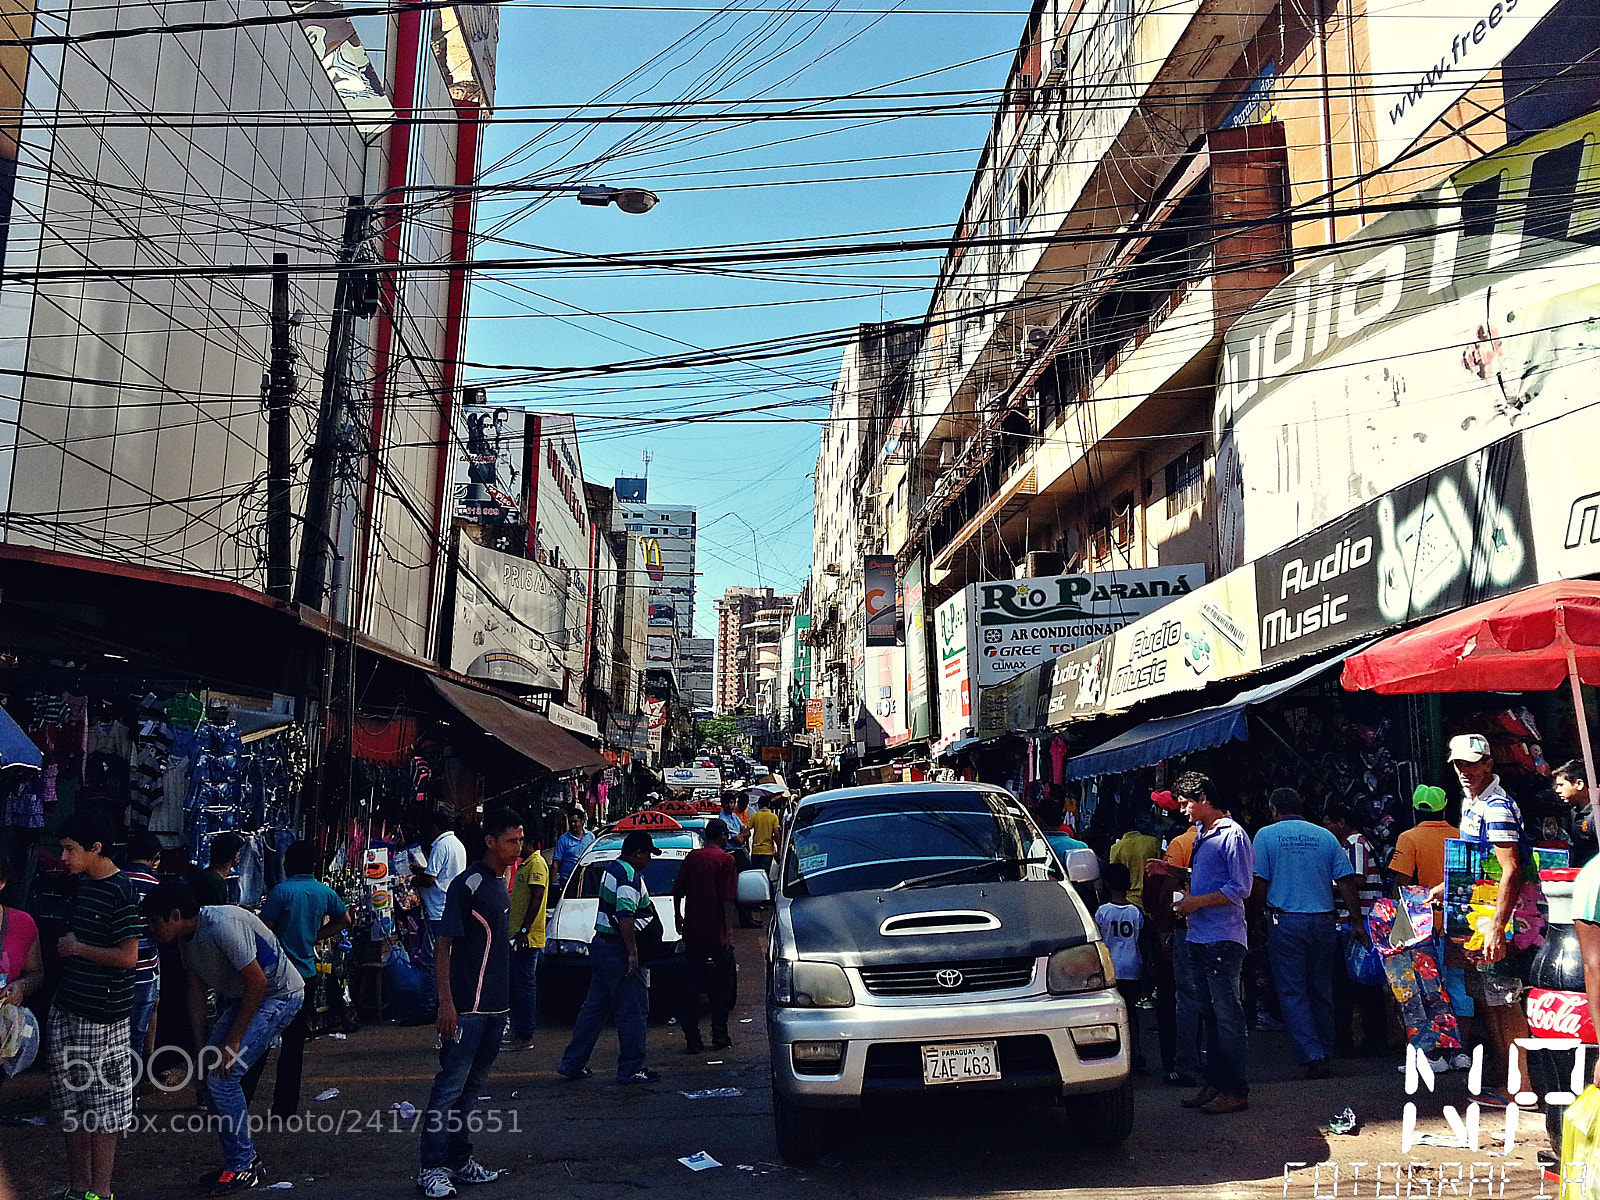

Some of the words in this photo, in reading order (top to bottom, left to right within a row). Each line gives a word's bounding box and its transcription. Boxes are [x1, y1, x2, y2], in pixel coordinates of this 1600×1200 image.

[1280, 535, 1374, 601] Audio
[1261, 592, 1350, 652] Music
[1010, 628, 1029, 640] AR
[1129, 620, 1183, 662] Audio
[1000, 645, 1042, 657] GREE
[991, 661, 1027, 670] CLIMAX
[1111, 657, 1168, 697] Music
[807, 700, 821, 708] Pro
[1036, 690, 1068, 717] Msic
[658, 803, 692, 811] TAXI
[630, 814, 664, 825] TAXI
[1110, 920, 1134, 938] 10
[941, 1048, 977, 1057] PARAGUAY
[930, 1057, 959, 1078] ZAE
[963, 1055, 991, 1077] 463
